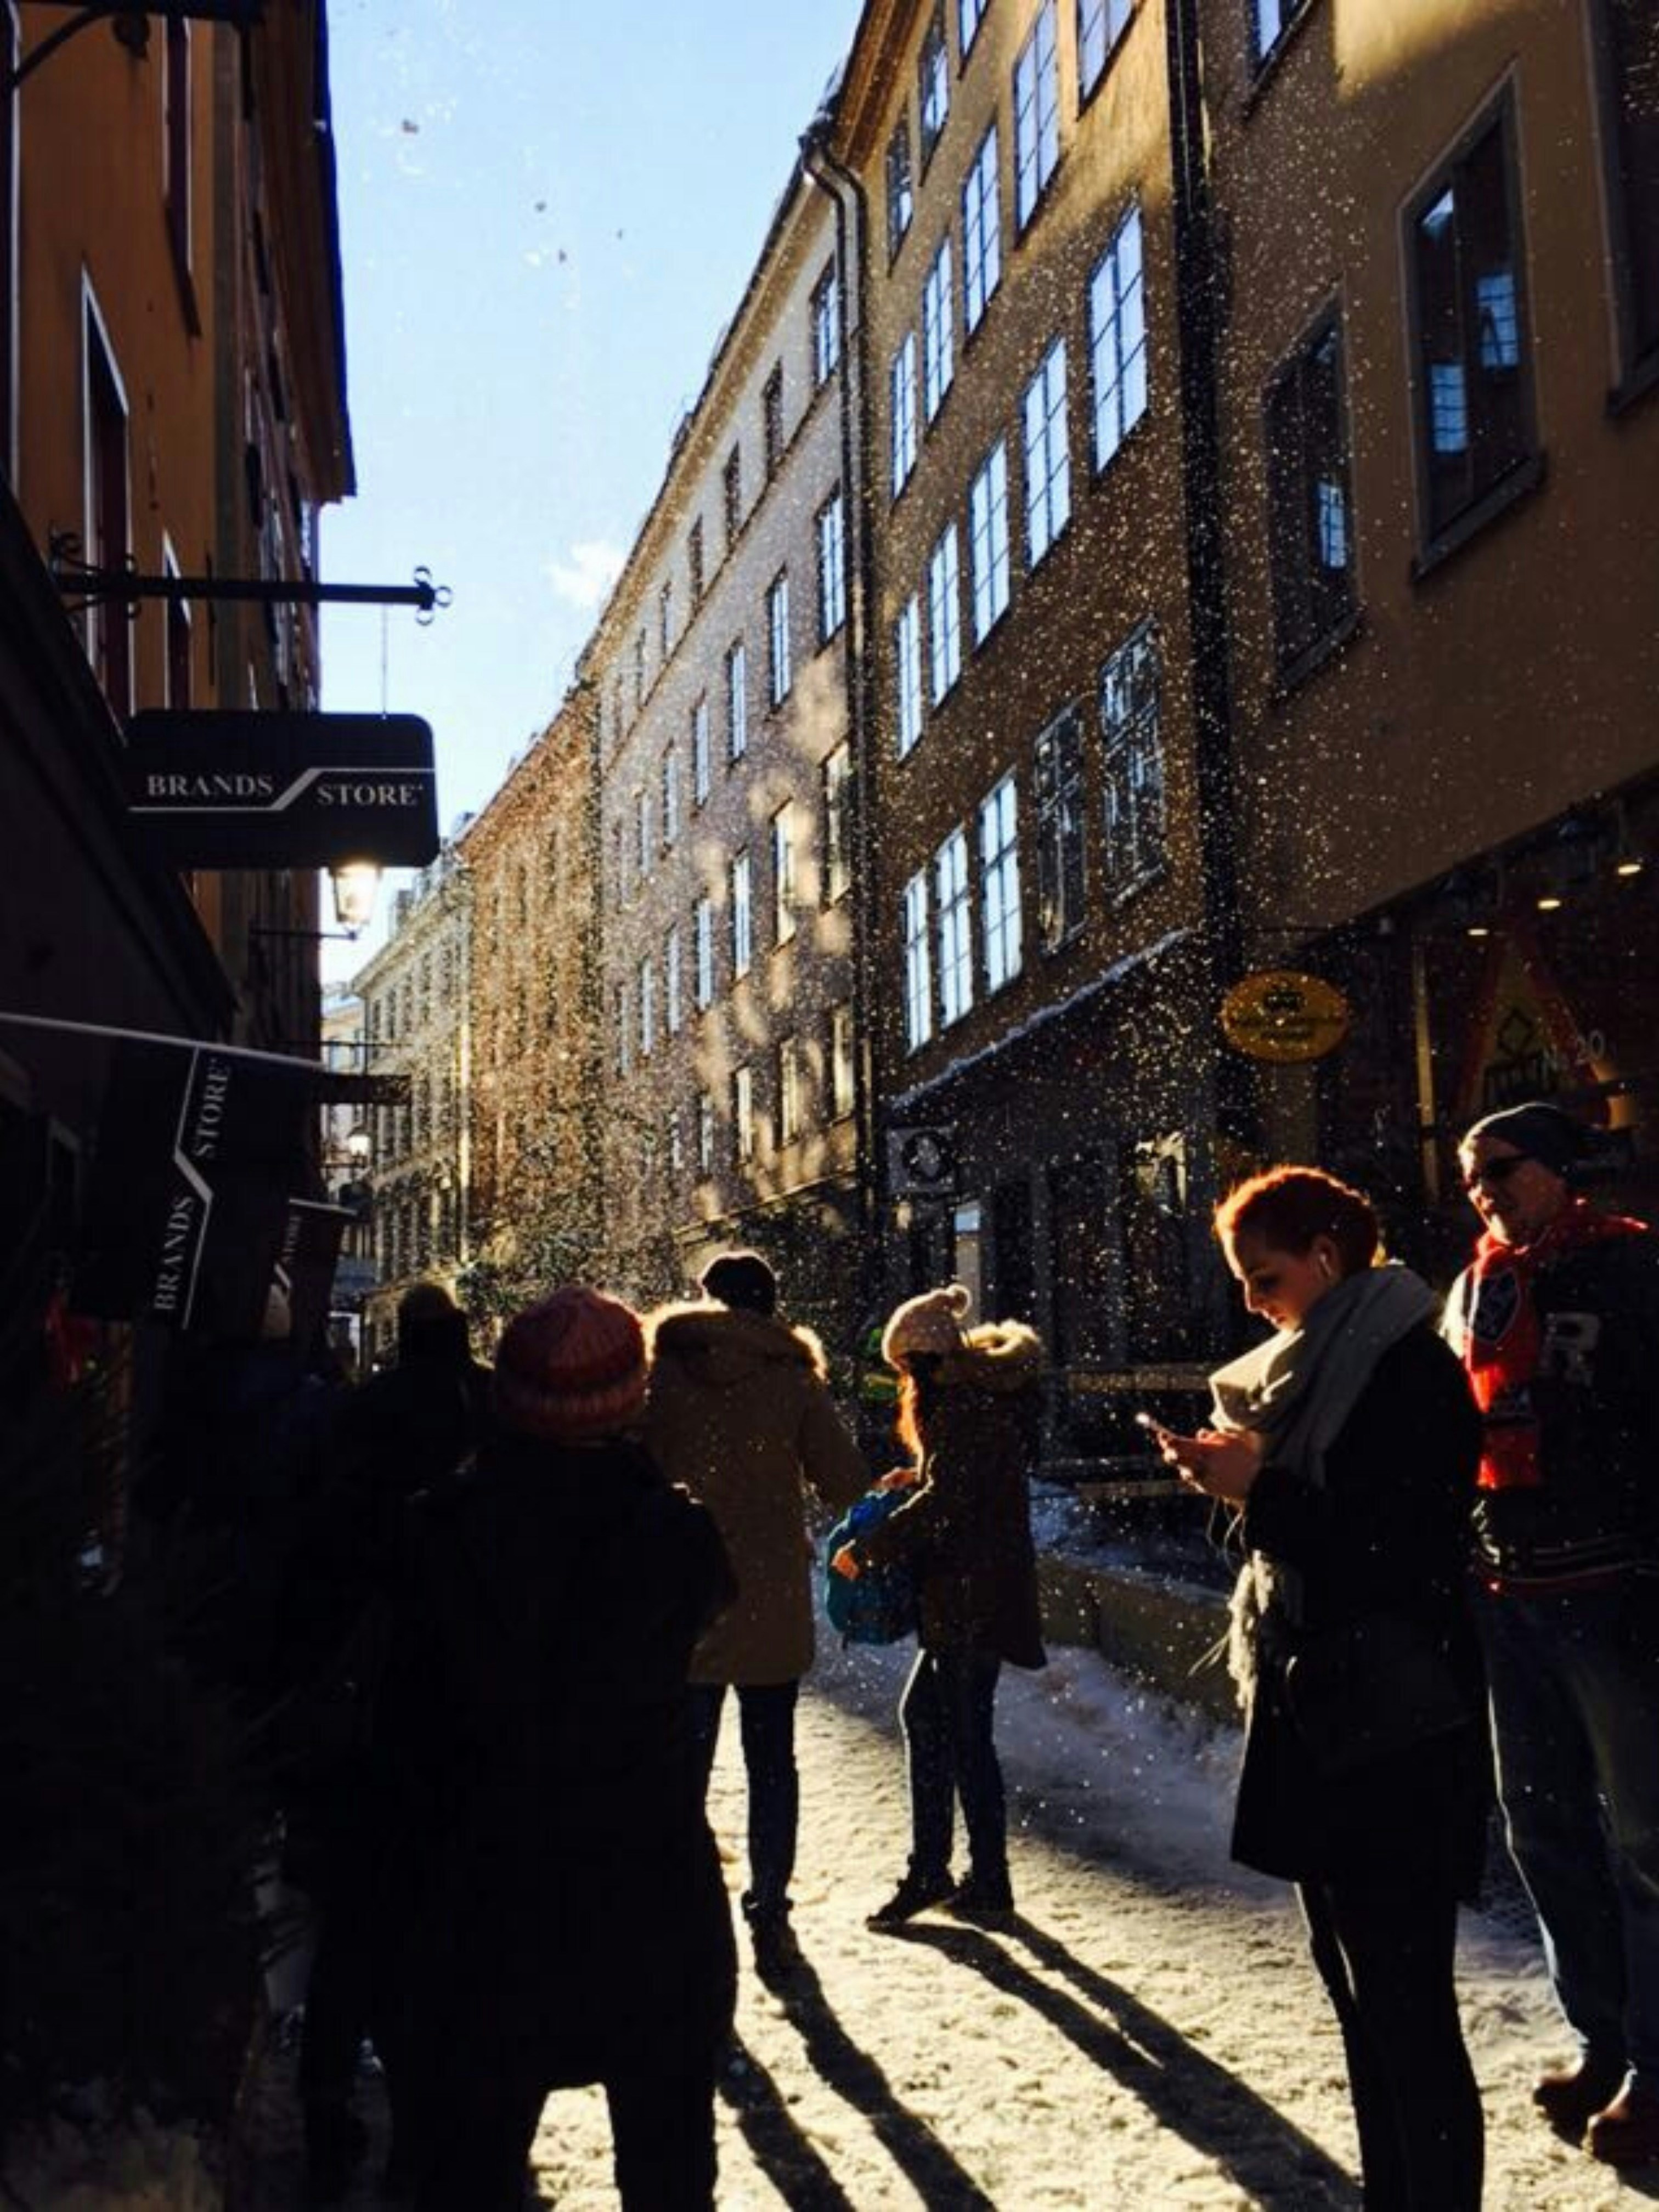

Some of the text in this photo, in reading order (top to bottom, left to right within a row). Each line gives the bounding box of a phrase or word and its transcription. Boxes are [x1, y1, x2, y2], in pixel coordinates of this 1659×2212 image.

[146, 771, 419, 807] BRANDS STORE
[153, 1063, 230, 1311] BRANDS STORE
